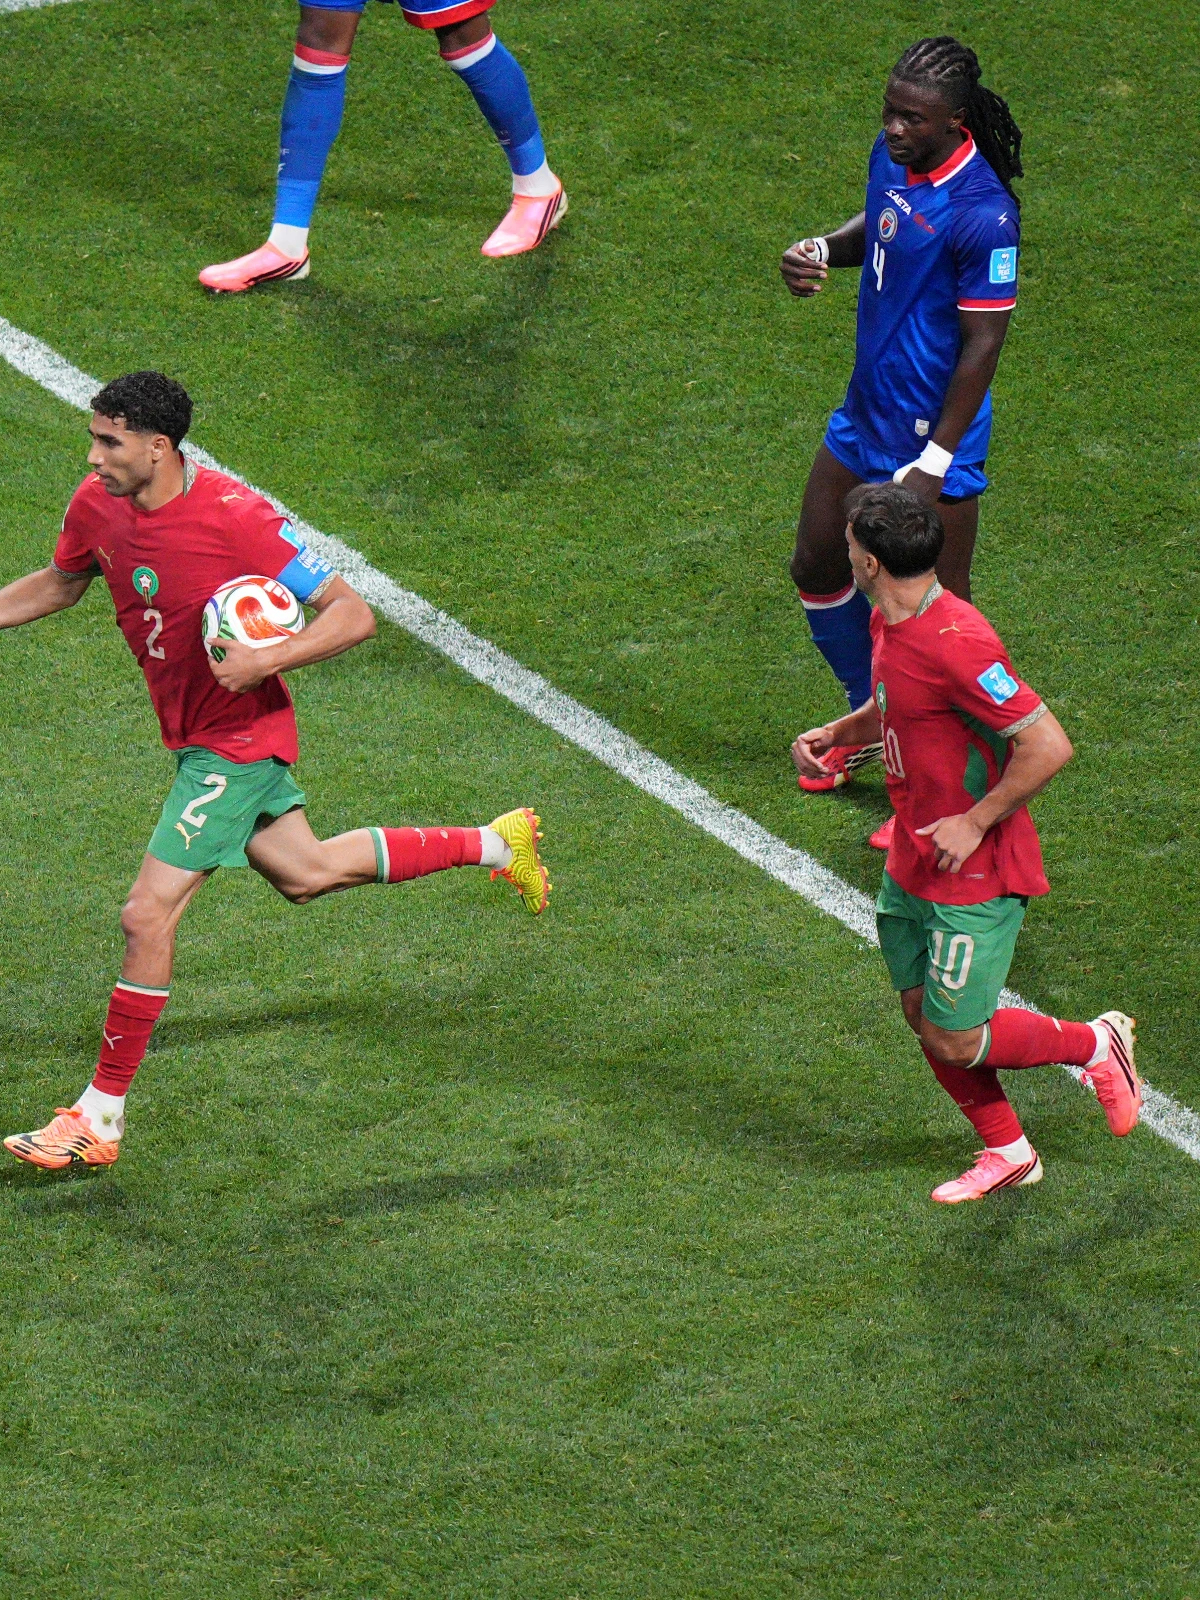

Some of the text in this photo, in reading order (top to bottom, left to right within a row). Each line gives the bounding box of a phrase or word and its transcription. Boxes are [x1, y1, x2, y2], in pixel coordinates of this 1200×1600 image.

[885, 189, 912, 216] SAETA
[872, 241, 885, 292] 4
[143, 607, 166, 661] 2
[180, 773, 228, 829] 2
[928, 930, 975, 990] 10
